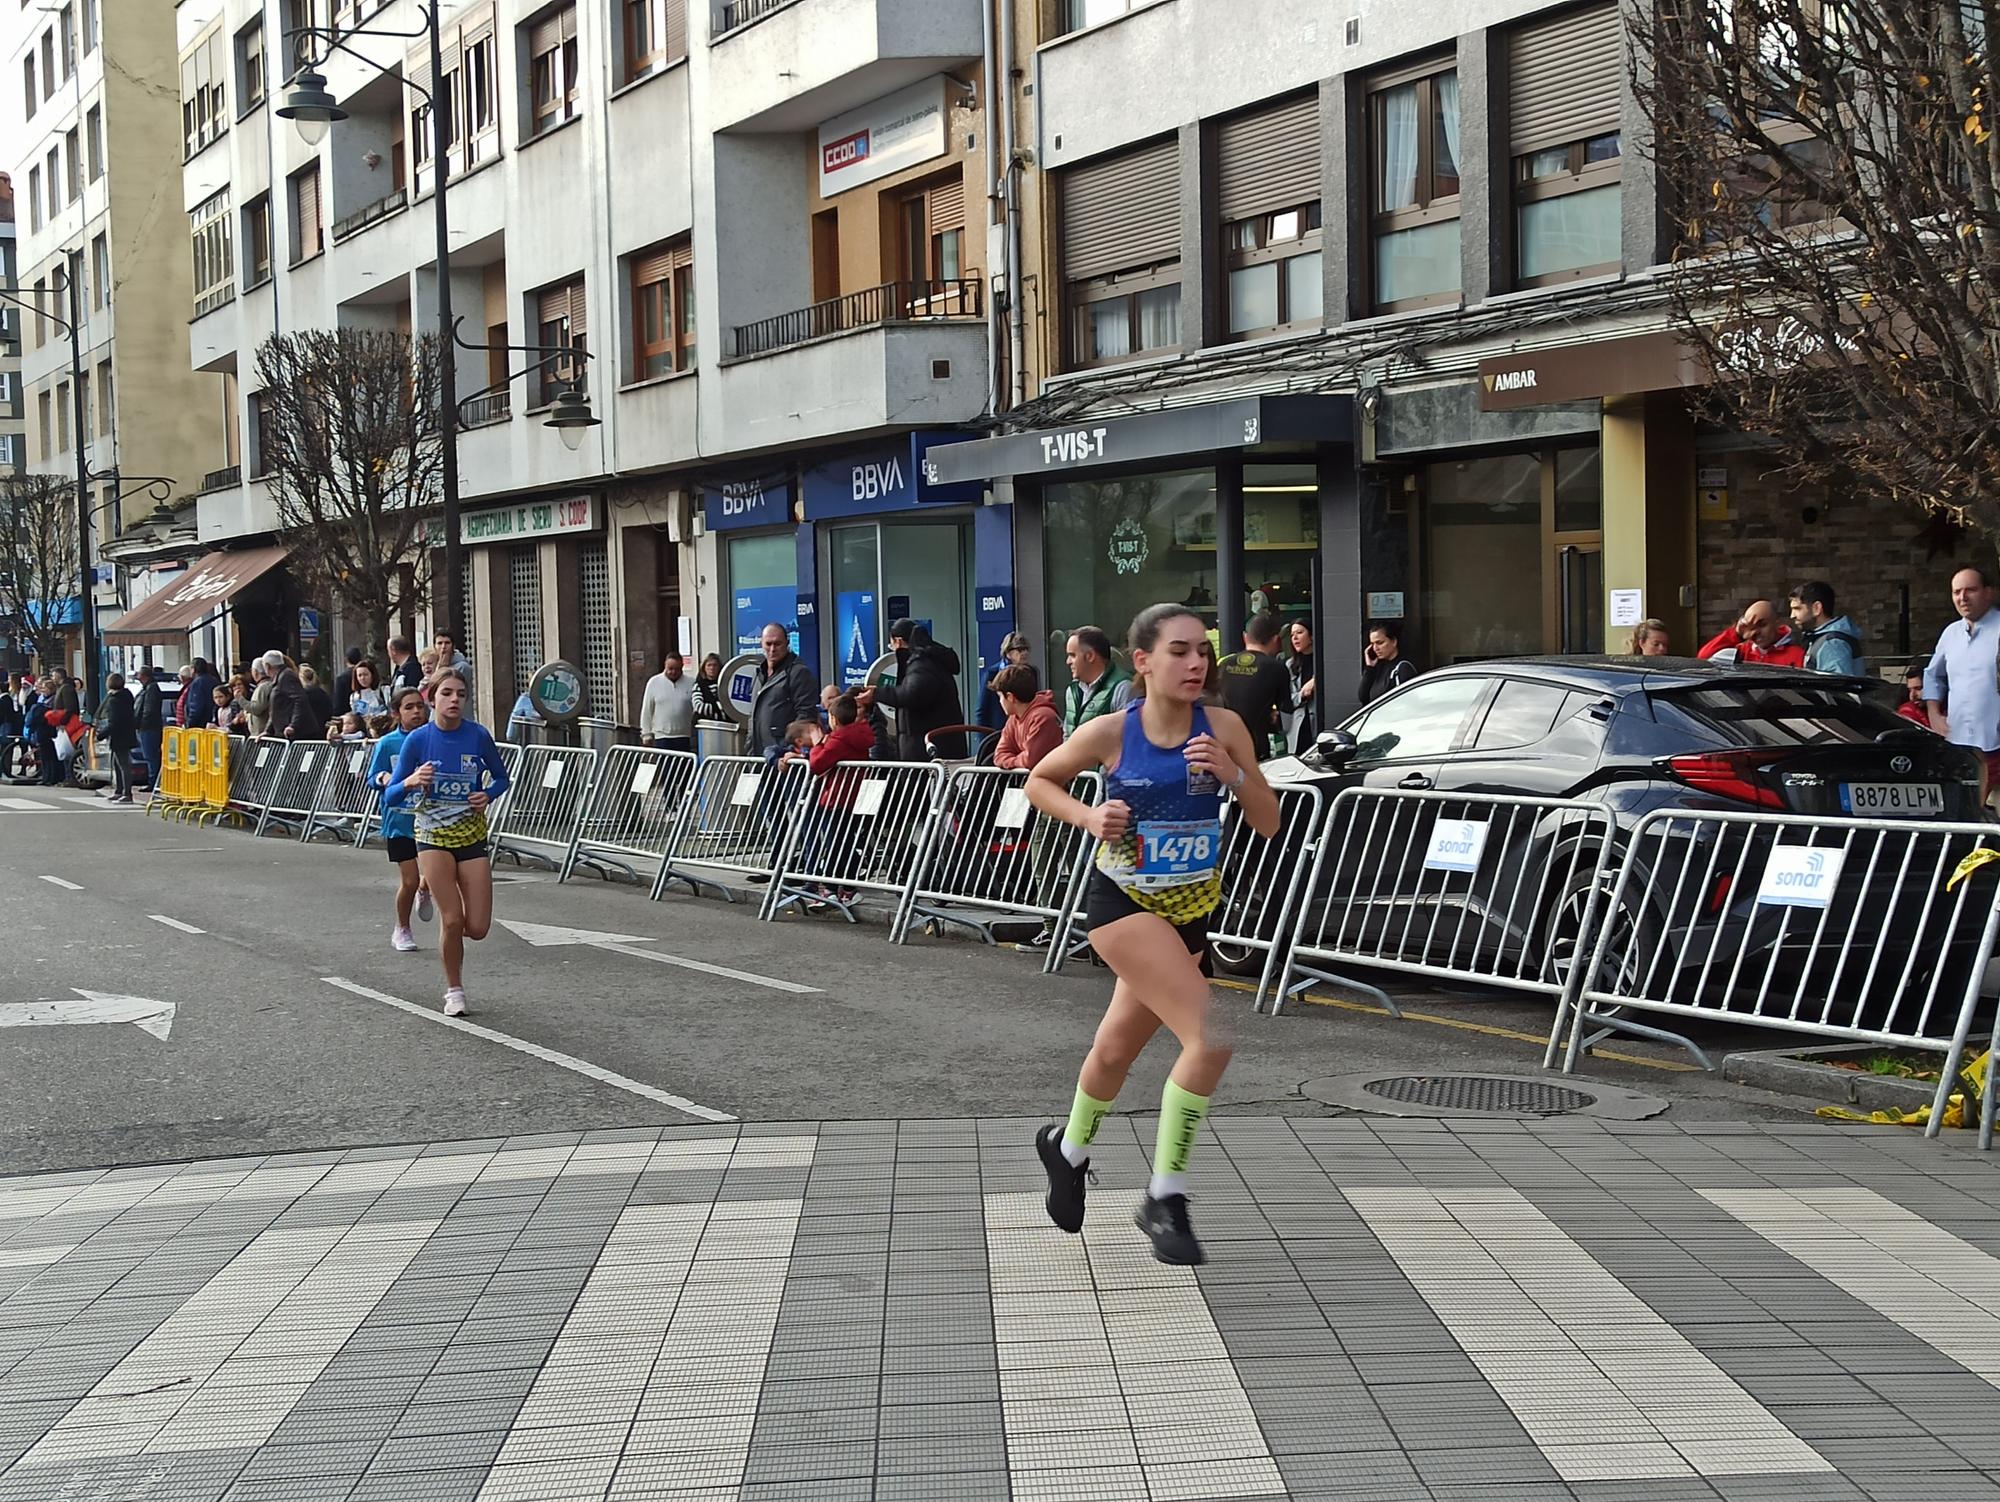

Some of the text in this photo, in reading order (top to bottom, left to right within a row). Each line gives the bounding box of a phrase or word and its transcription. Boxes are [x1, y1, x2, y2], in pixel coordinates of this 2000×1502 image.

[825, 140, 856, 167] CCOO
[1494, 369, 1537, 391] AMBAR
[1040, 427, 1107, 464] T-VIS-T
[852, 456, 904, 501] BBVA
[722, 479, 765, 516] BBVA
[797, 602, 814, 615] BBVA
[982, 595, 1005, 611] BBVA
[433, 781, 471, 795] 1493
[1855, 787, 1940, 808] 8878 LPM
[1148, 835, 1210, 862] 1478
[1437, 840, 1474, 854] sonar
[1775, 872, 1824, 888] sonar
